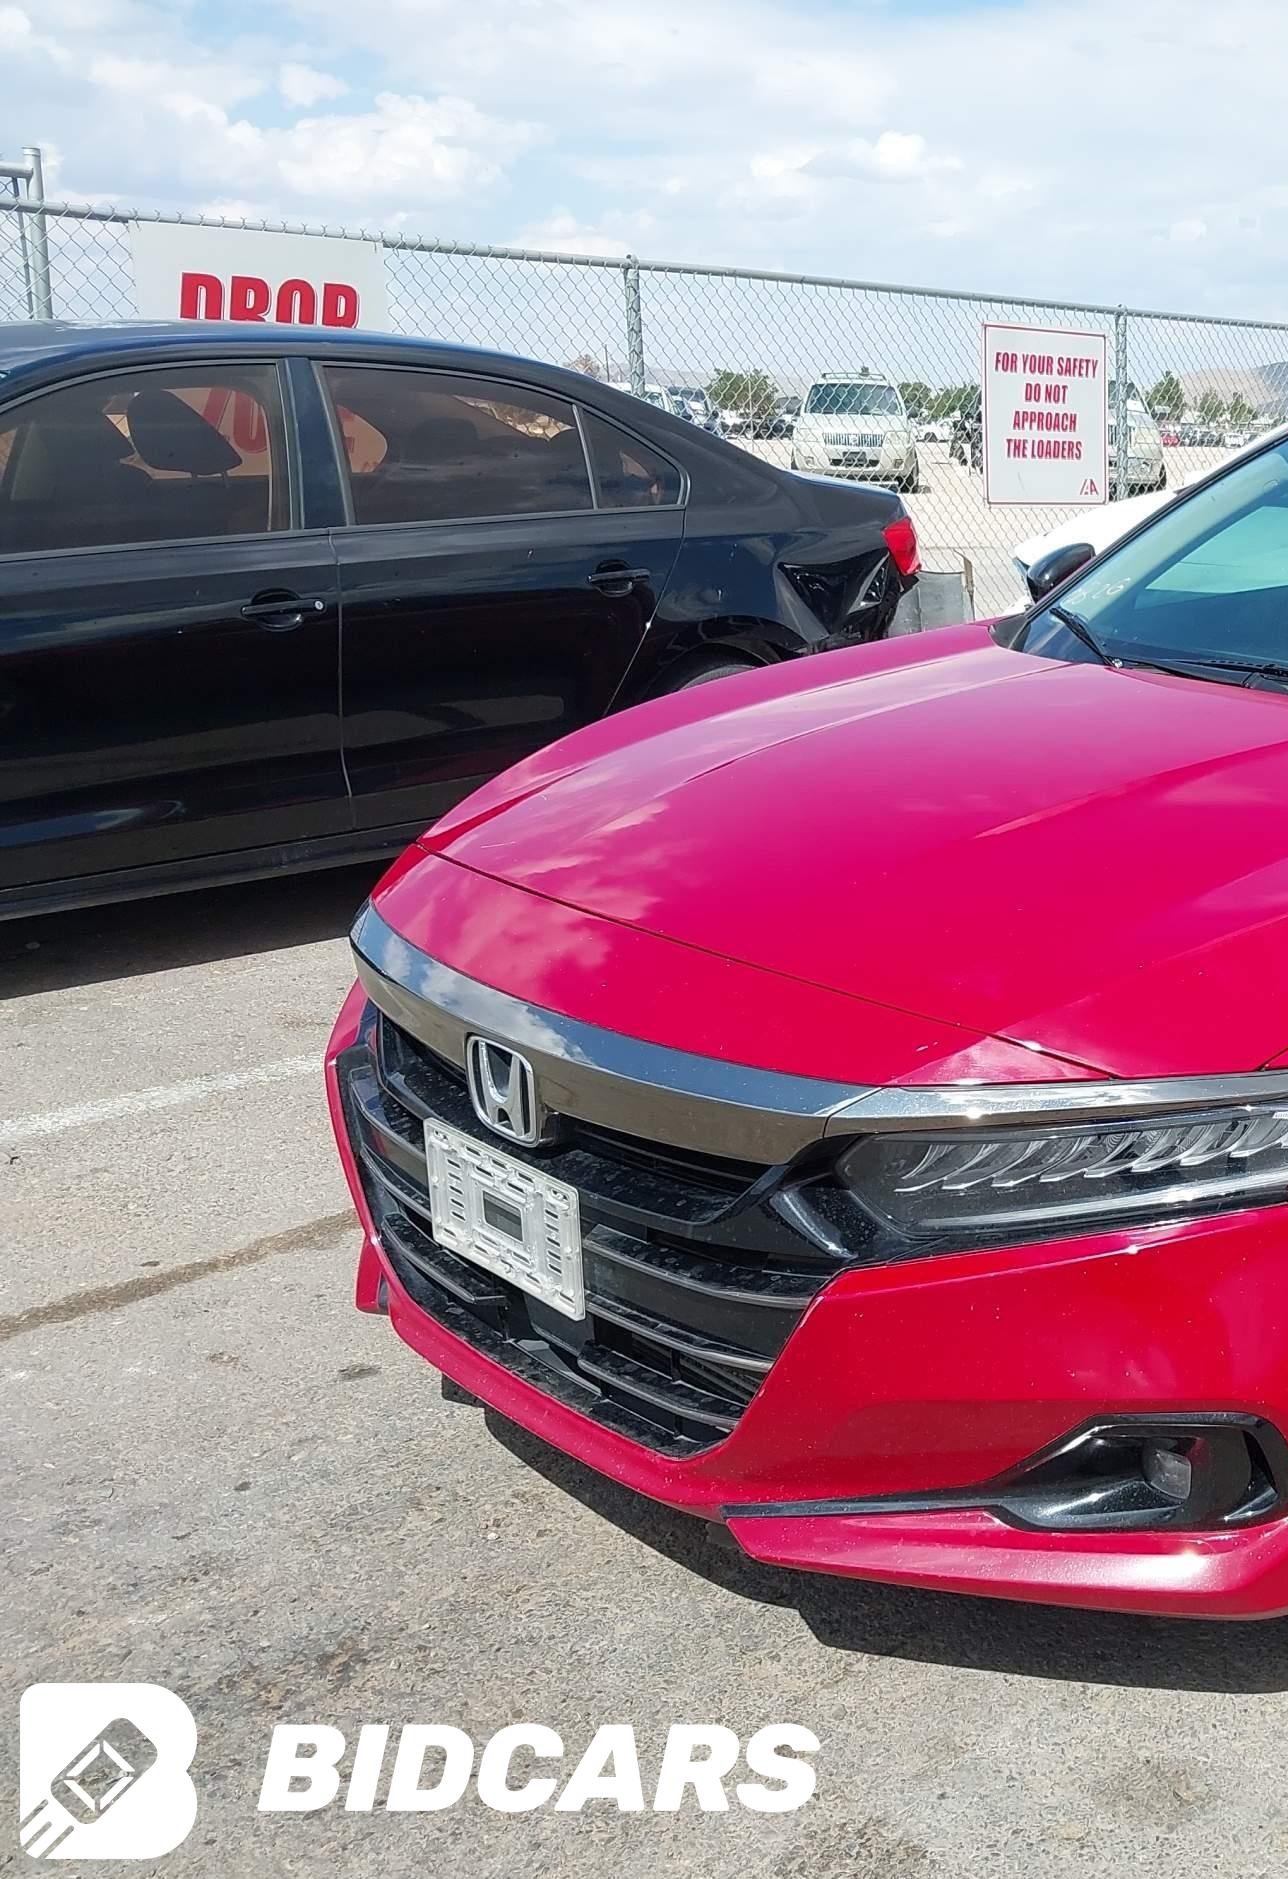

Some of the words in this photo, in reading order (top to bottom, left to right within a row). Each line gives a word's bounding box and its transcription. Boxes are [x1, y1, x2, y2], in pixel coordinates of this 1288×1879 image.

[995, 352, 1018, 373] FOR
[1022, 353, 1054, 376] YOUR
[1057, 356, 1099, 379] SAFETY
[1025, 383, 1041, 402] DO
[1045, 384, 1068, 404] NOT
[1013, 410, 1077, 433] APPROACH
[1006, 438, 1027, 459] THE
[1031, 439, 1083, 461] LOADERS
